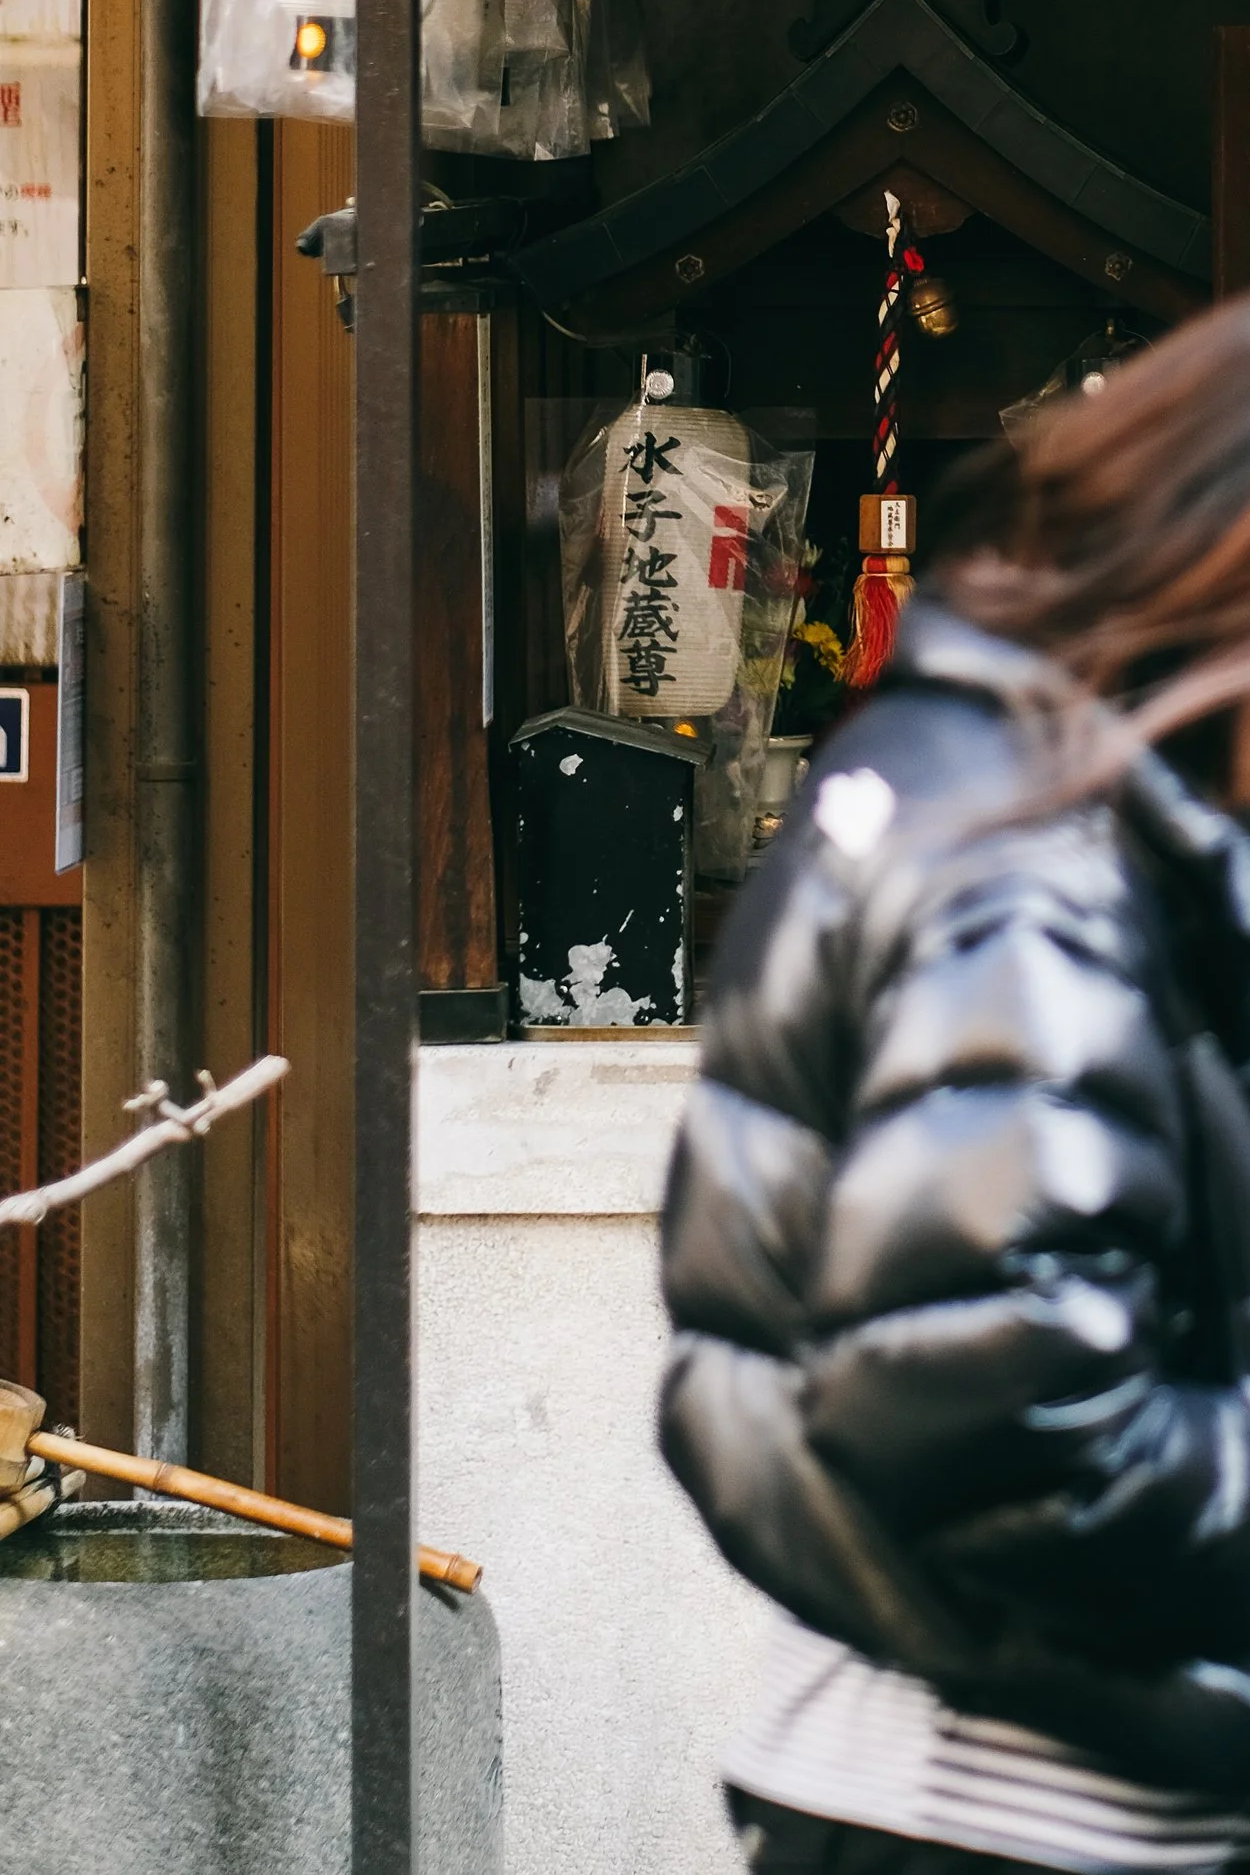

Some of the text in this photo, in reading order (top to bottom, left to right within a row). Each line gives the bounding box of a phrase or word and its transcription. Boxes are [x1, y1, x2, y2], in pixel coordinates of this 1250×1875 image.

[618, 431, 684, 698] 水子地蔵尊
